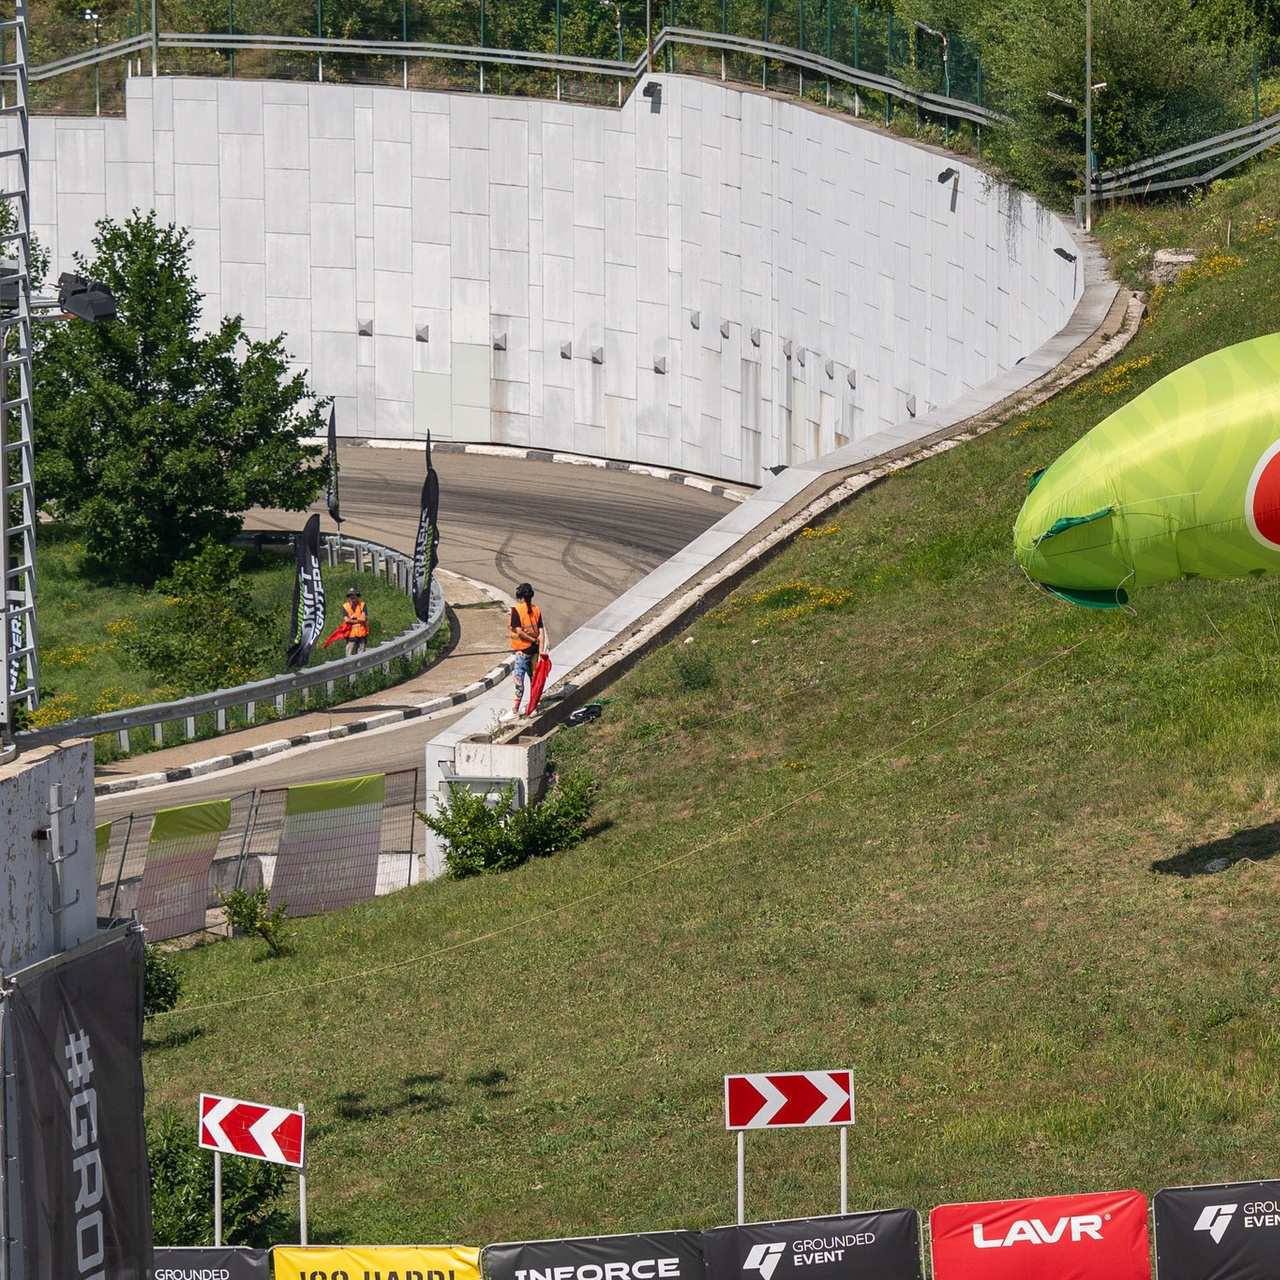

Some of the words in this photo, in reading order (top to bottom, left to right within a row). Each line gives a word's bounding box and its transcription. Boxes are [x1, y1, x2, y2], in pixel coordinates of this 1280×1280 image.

[792, 1232, 876, 1252] GROUNDED
[972, 1214, 1104, 1250] LAVR
[793, 1249, 846, 1266] EVENT
